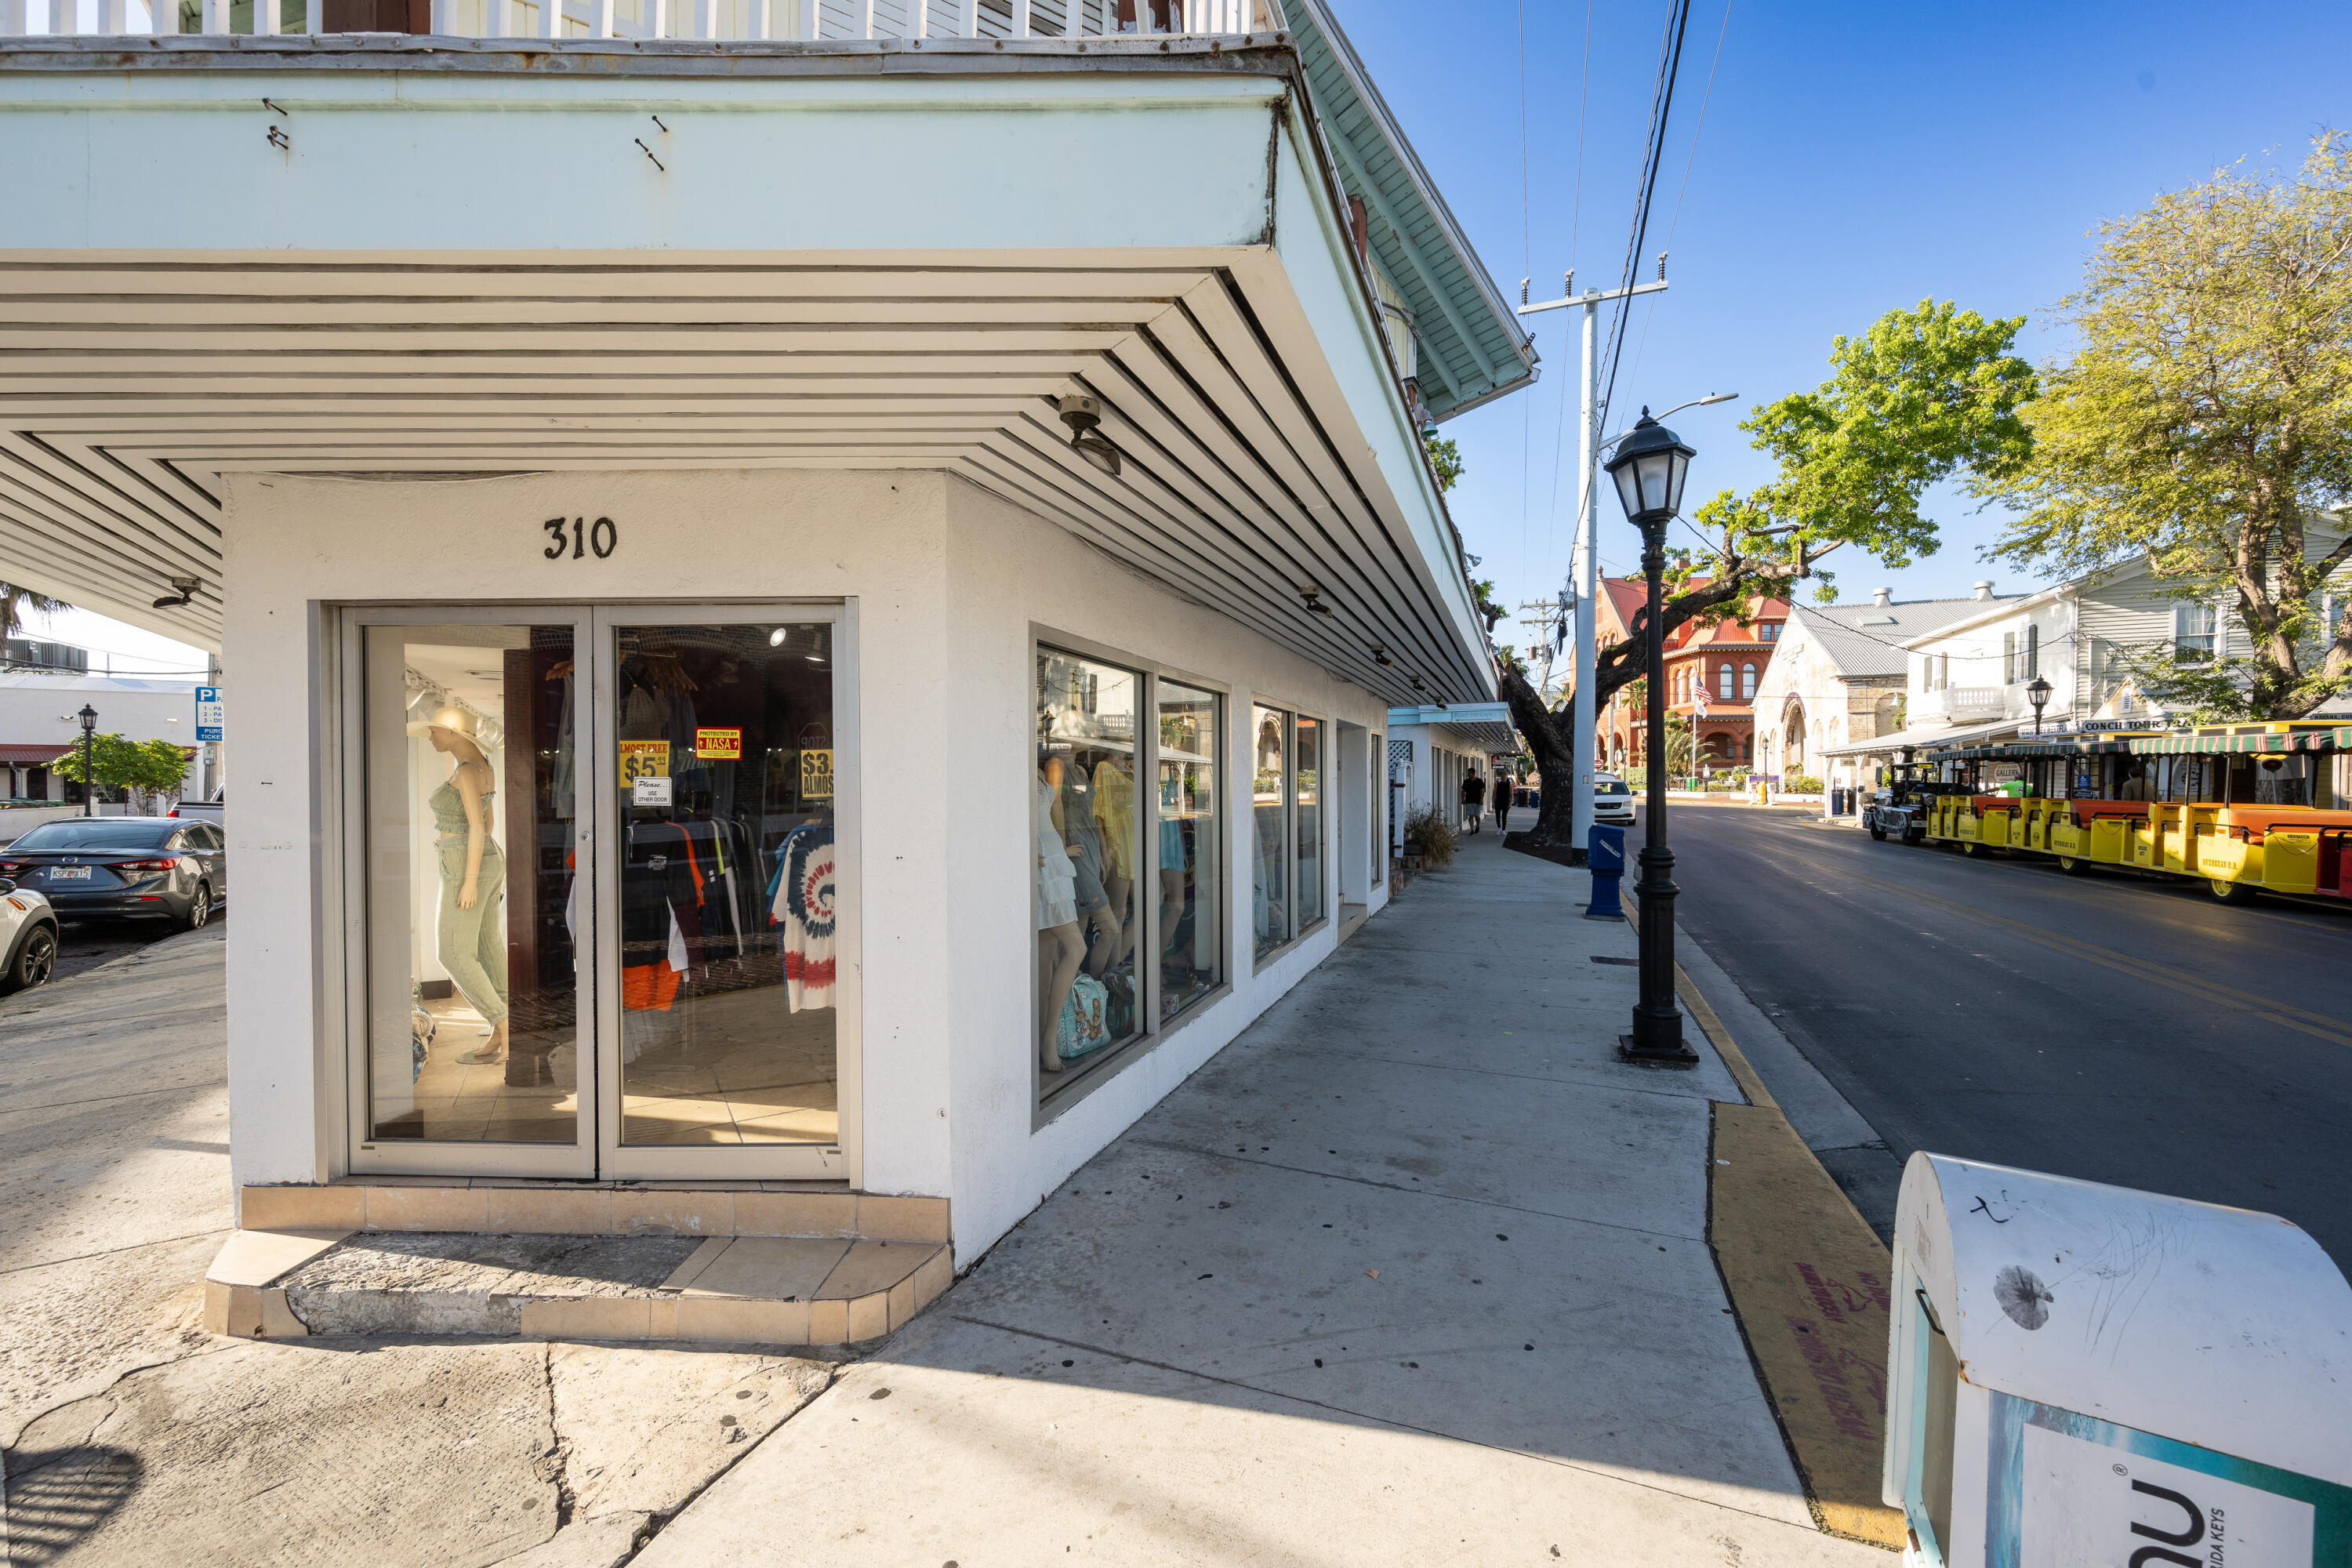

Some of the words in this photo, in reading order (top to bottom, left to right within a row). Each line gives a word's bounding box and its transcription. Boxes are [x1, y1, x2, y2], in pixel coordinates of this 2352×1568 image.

[544, 517, 617, 560] 310
[200, 689, 213, 701] P
[2085, 721, 2122, 731] CONCH
[706, 738, 731, 750] NASA
[2210, 1508, 2225, 1542] KEYS
